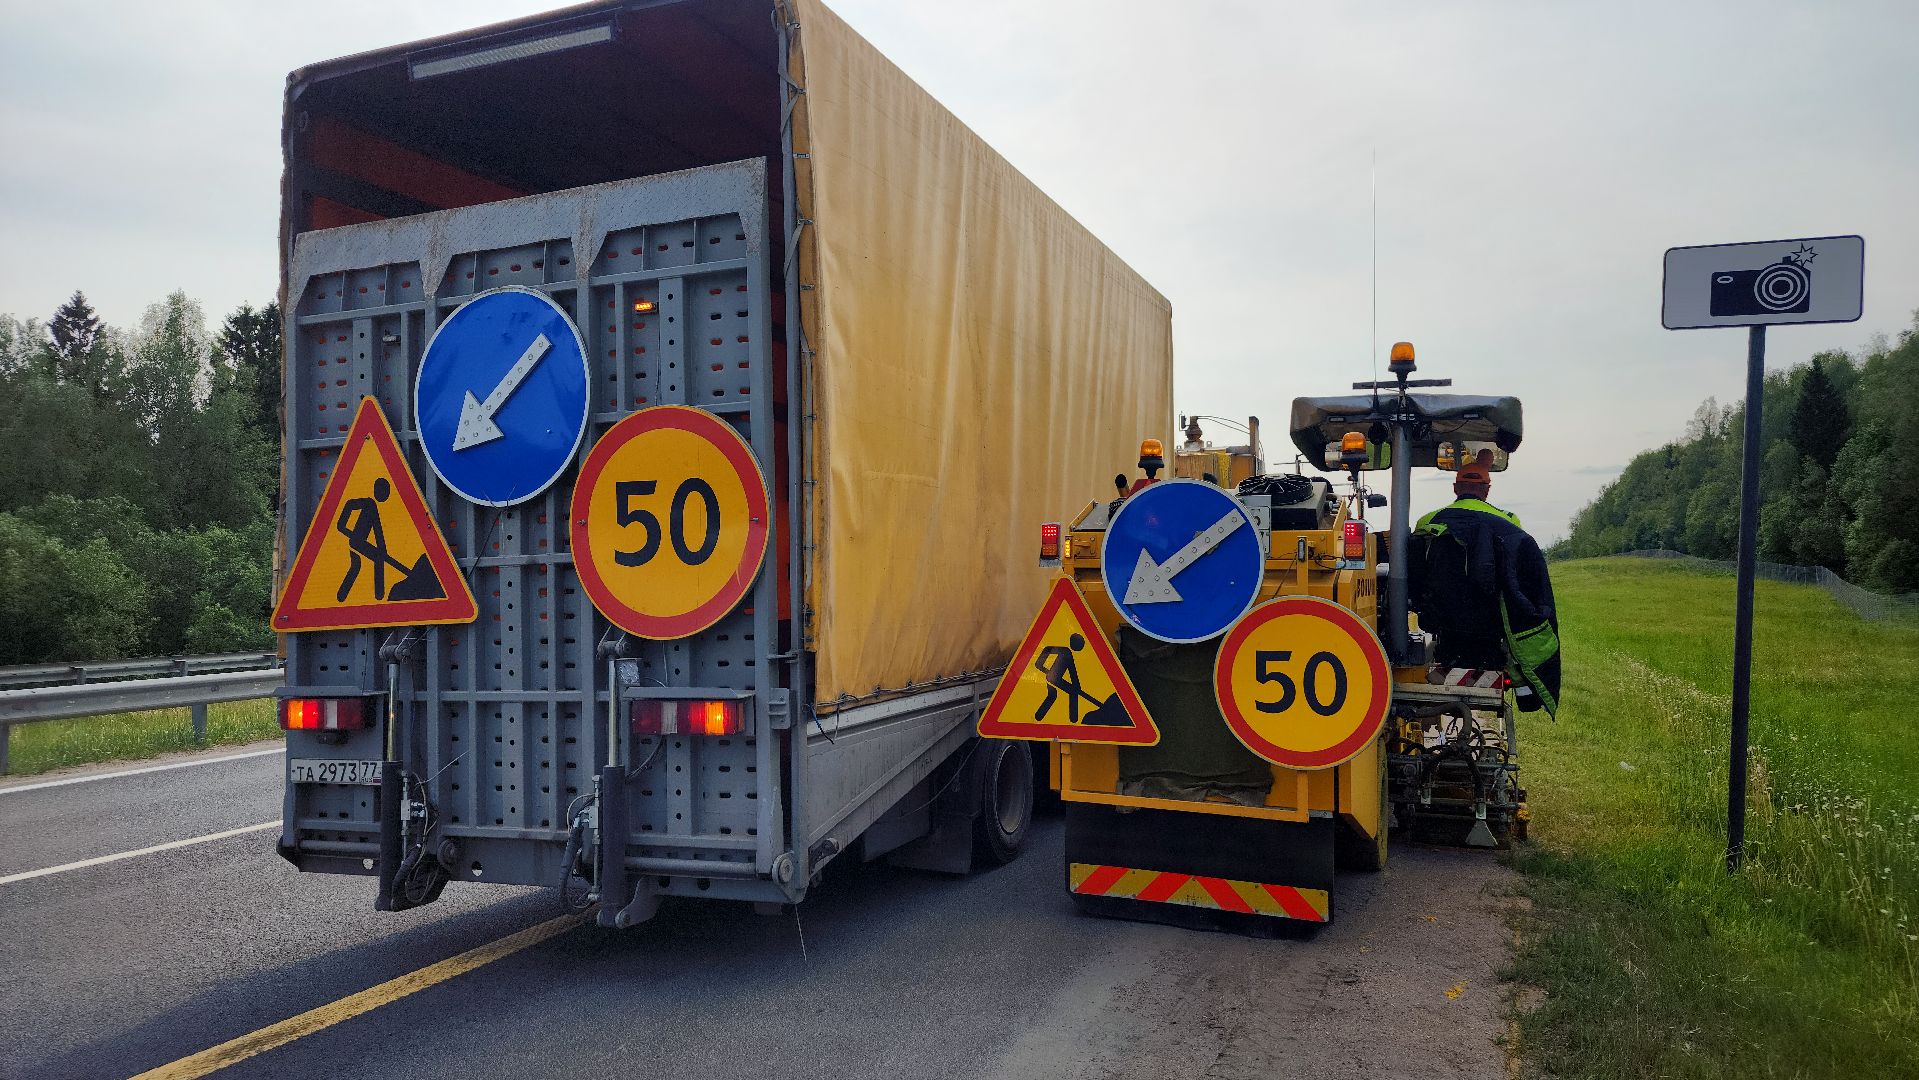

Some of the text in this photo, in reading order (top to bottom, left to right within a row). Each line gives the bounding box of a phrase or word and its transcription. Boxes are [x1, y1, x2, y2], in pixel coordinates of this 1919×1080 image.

[614, 477, 721, 567] 50
[1255, 650, 1348, 717] 50
[318, 762, 357, 782] 2973
[361, 761, 377, 777] 77
